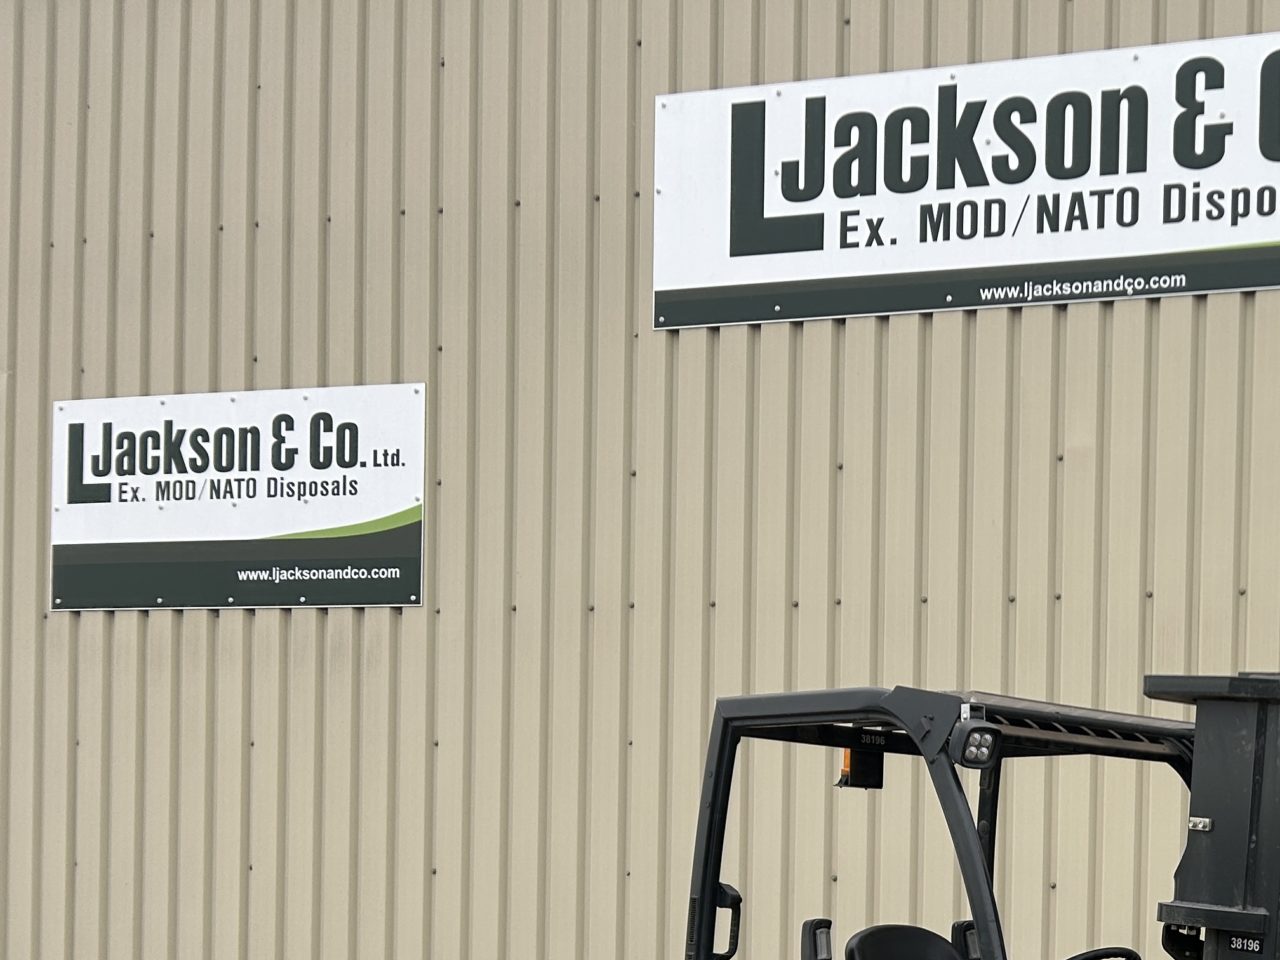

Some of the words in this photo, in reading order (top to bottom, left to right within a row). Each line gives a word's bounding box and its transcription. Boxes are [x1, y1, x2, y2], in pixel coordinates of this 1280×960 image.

[1171, 55, 1233, 170] &
[838, 208, 898, 249] Ex.
[919, 185, 1139, 243] MOD/NATO
[979, 273, 1187, 301] www.ljacksonandco.com
[271, 413, 299, 471] &
[309, 411, 367, 470] Co.
[372, 448, 405, 468] Ltd.
[118, 481, 146, 503] Ex.
[155, 477, 257, 501] MOD/NATO
[266, 475, 359, 500] Disposals
[237, 565, 401, 584] www.ljacksonandco.com
[861, 734, 885, 745] 38196
[1230, 936, 1261, 952] 38196
